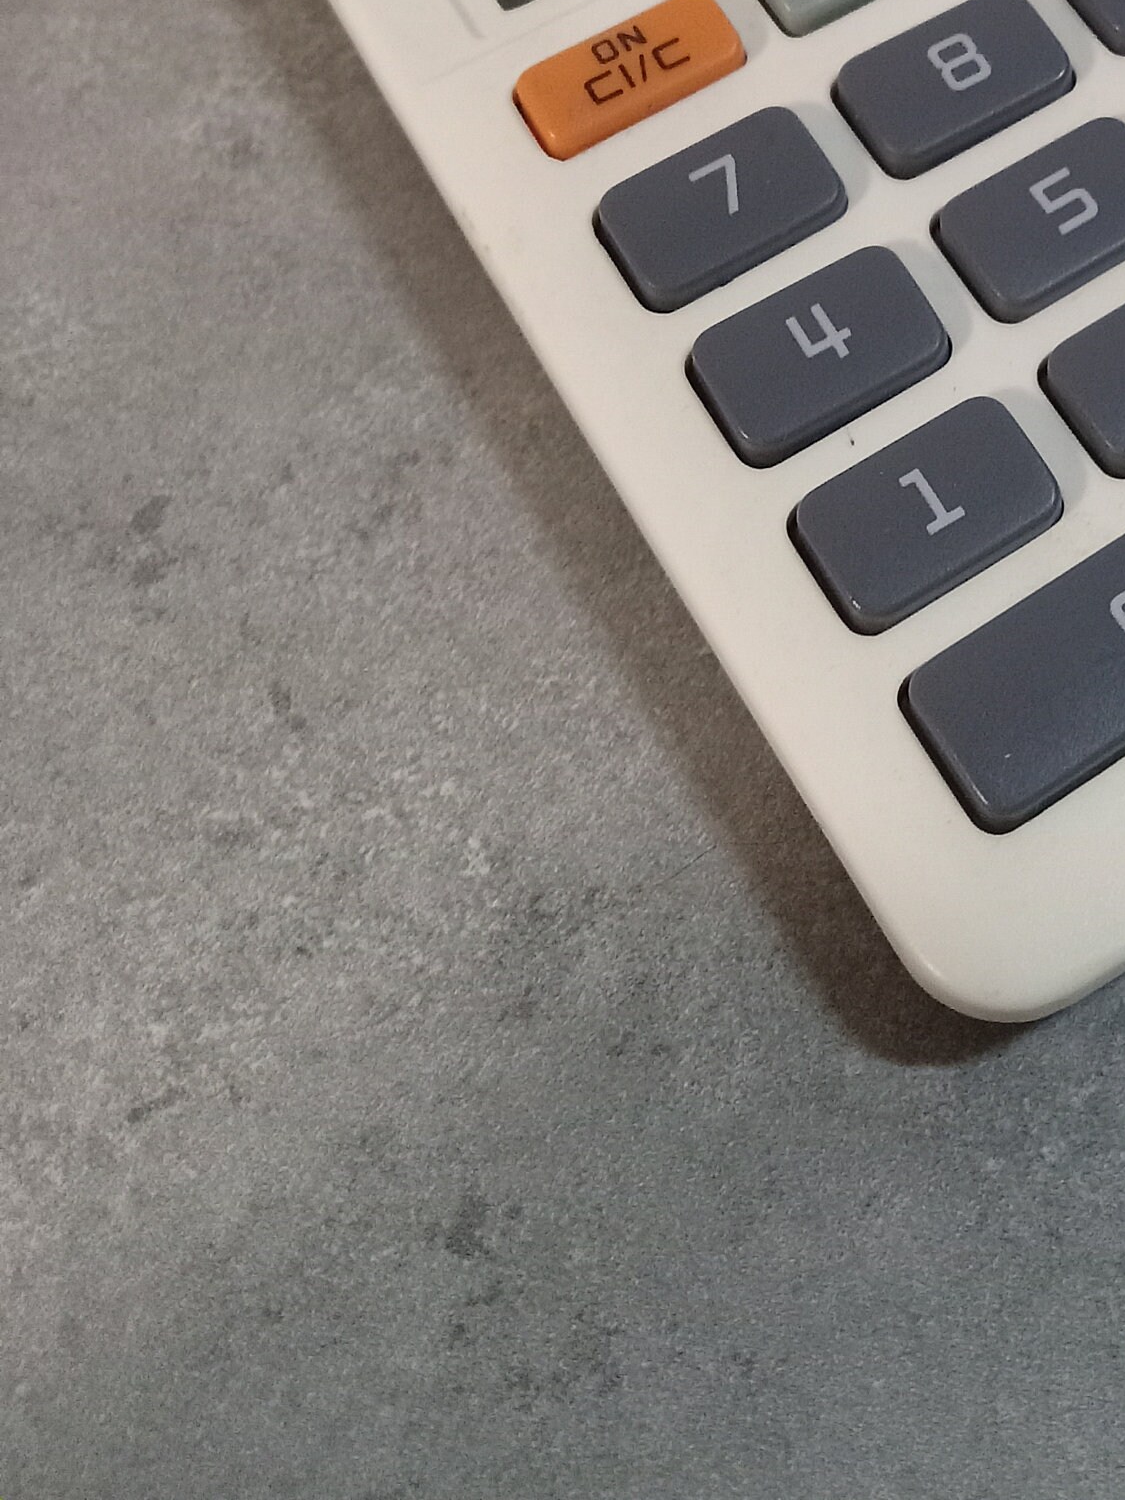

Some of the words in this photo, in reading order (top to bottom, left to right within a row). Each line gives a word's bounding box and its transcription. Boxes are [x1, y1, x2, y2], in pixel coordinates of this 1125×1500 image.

[590, 24, 647, 65] ON
[926, 32, 992, 92] 8
[688, 153, 740, 215] 7
[1028, 166, 1099, 236] 5
[785, 303, 852, 360] 4
[898, 468, 966, 536] 1
